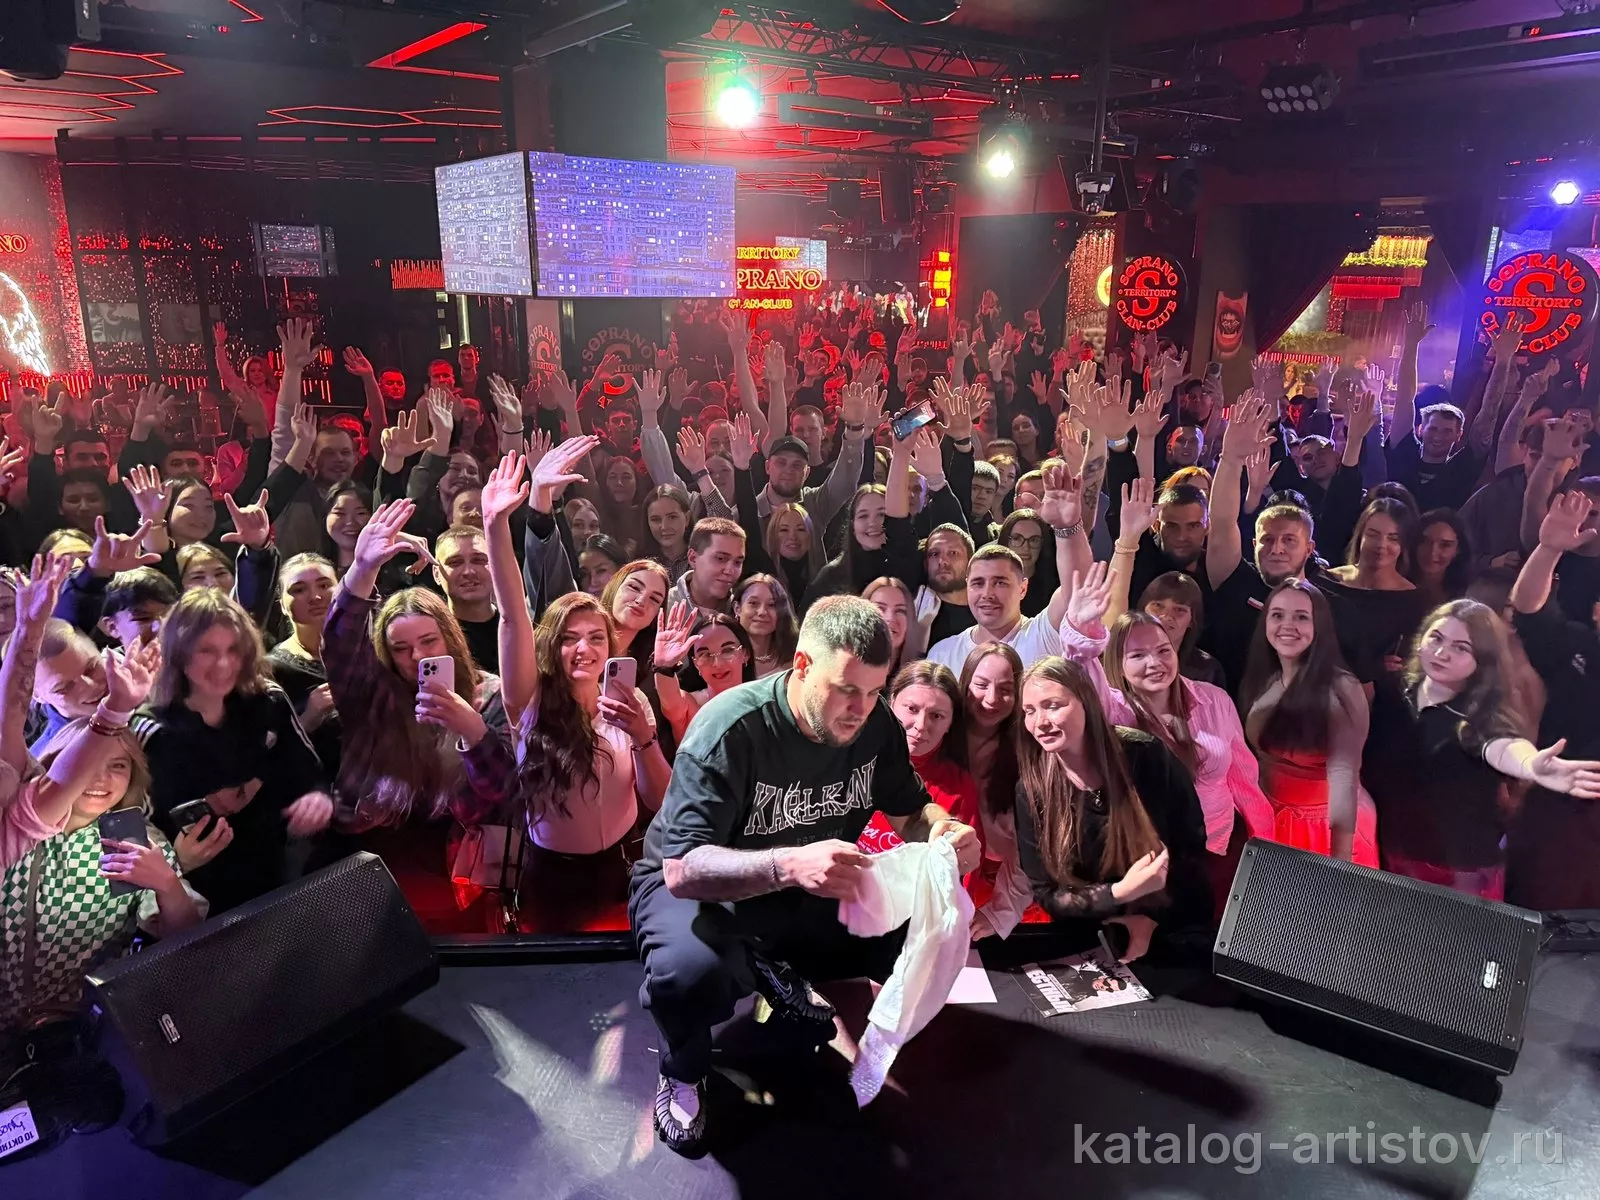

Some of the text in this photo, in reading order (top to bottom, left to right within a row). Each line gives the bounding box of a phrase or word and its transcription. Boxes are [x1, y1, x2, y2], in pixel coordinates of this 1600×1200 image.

[736, 246, 800, 260] RRITORY
[736, 268, 823, 290] PRANO
[1119, 255, 1179, 287] SOPRANO
[1487, 252, 1587, 294] SOPRANO
[1123, 288, 1172, 297] TERRITORY
[1494, 295, 1574, 308] TERRITORY
[1116, 299, 1177, 331] CLAN-CLUB
[581, 326, 653, 361] SOPRANO
[1481, 311, 1583, 353] CL-CLUB
